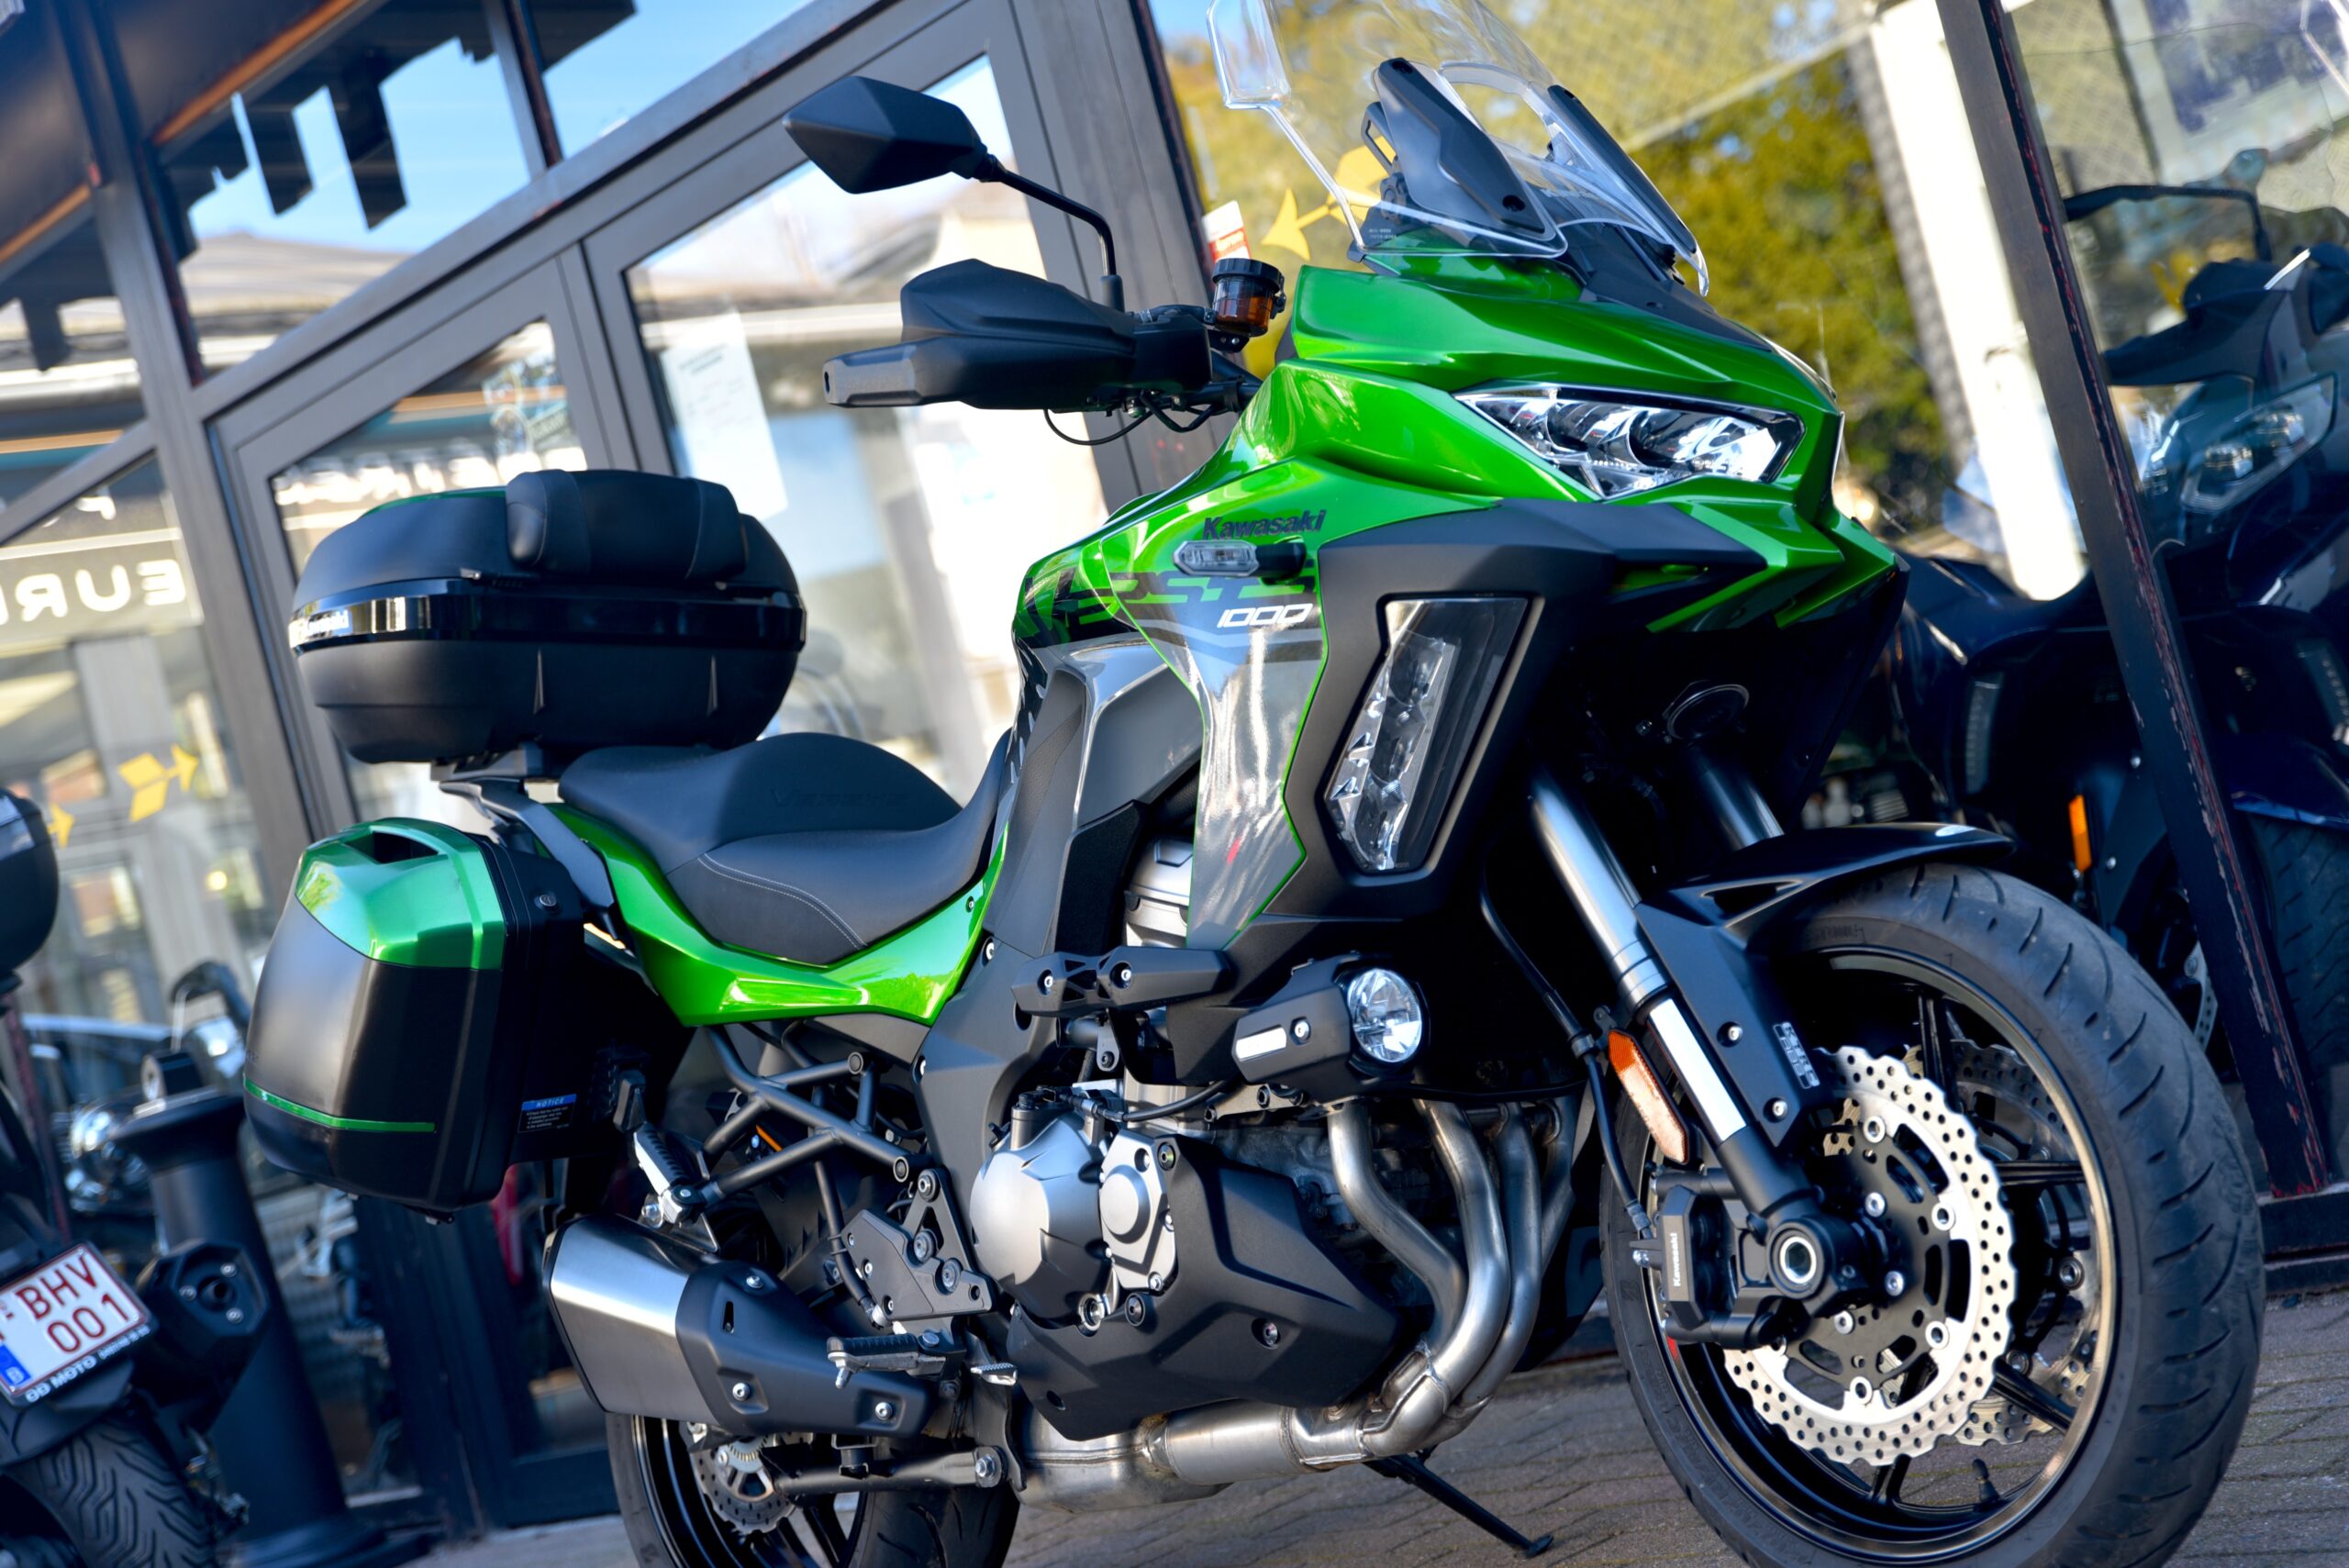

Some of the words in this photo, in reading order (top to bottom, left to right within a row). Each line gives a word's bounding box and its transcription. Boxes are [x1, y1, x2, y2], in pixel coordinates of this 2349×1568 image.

[1201, 509, 1327, 541] Kawasaki
[1217, 603, 1313, 628] 1000
[536, 1097, 565, 1108] NOTICE
[1670, 1232, 1681, 1287] Kawasaki
[47, 1293, 129, 1353] 001
[50, 1355, 97, 1388] MOTO
